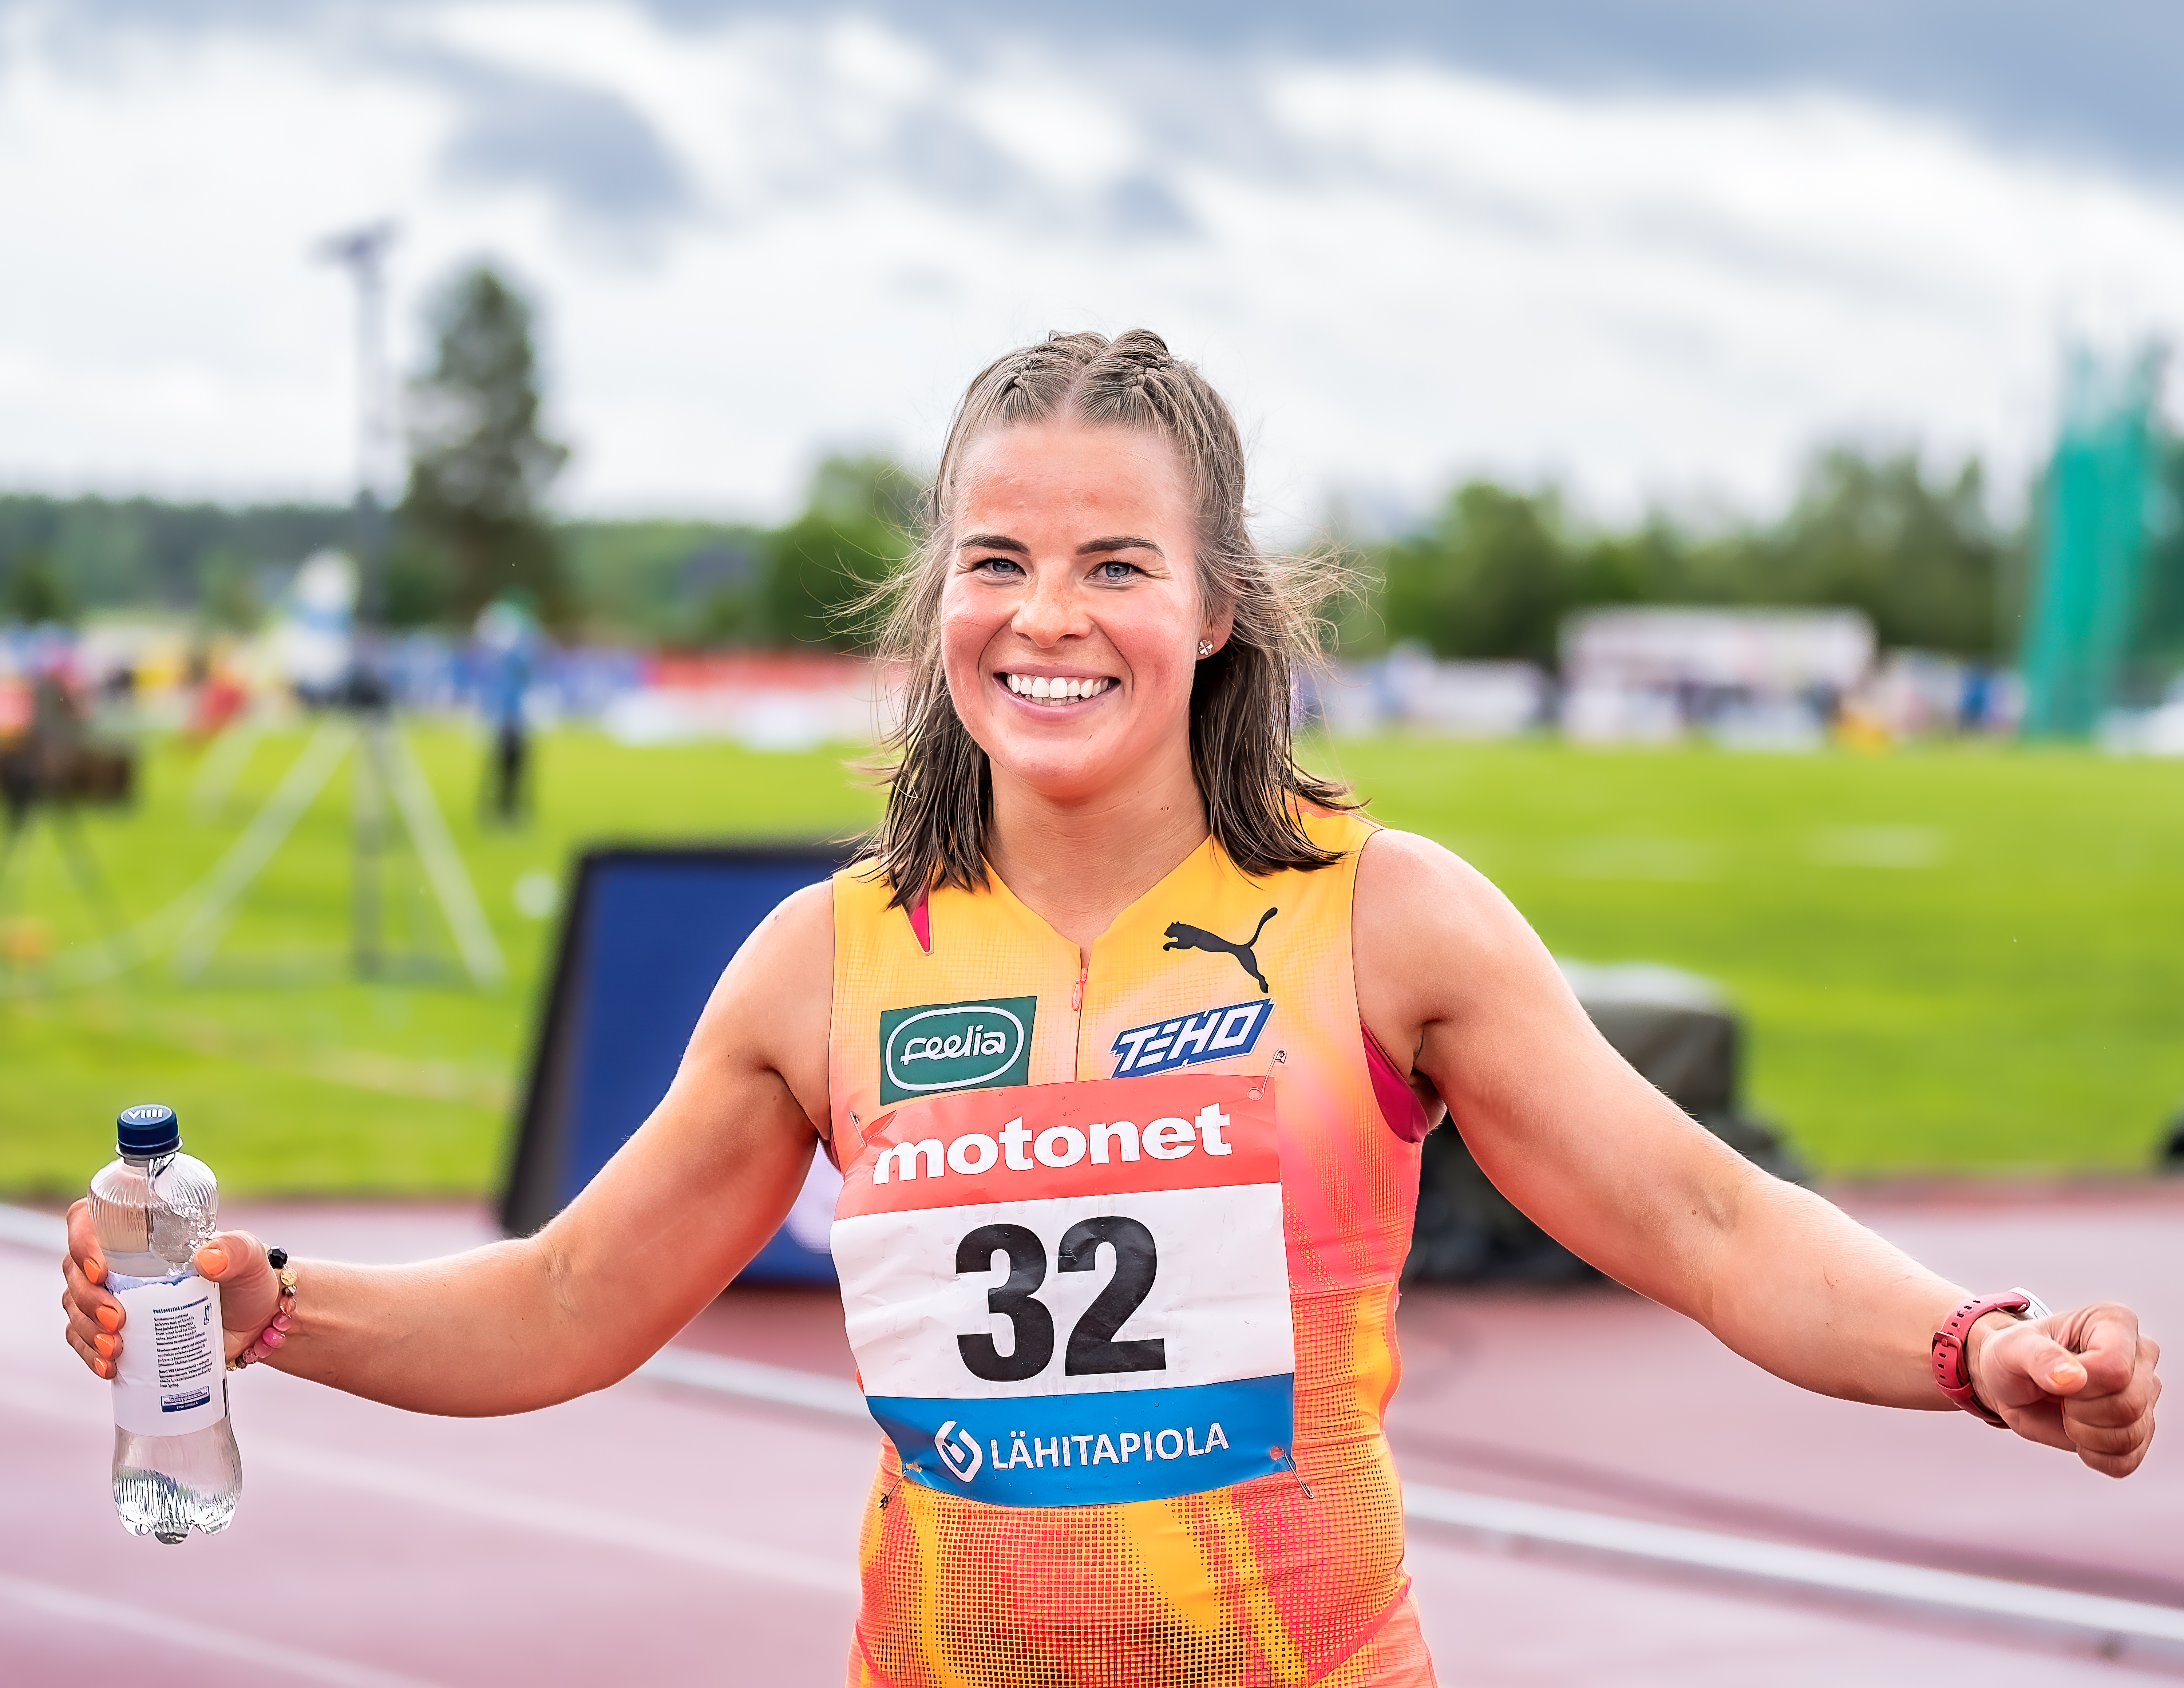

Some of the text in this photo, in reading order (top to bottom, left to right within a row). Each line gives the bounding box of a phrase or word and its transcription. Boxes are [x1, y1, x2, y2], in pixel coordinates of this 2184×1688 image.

[900, 1024, 1006, 1066] feelia
[1118, 1004, 1263, 1072] TEHO
[872, 1102, 1233, 1185] motonet
[955, 1215, 1167, 1382] 32
[990, 1422, 1230, 1471] LÄHITAPIOLA
